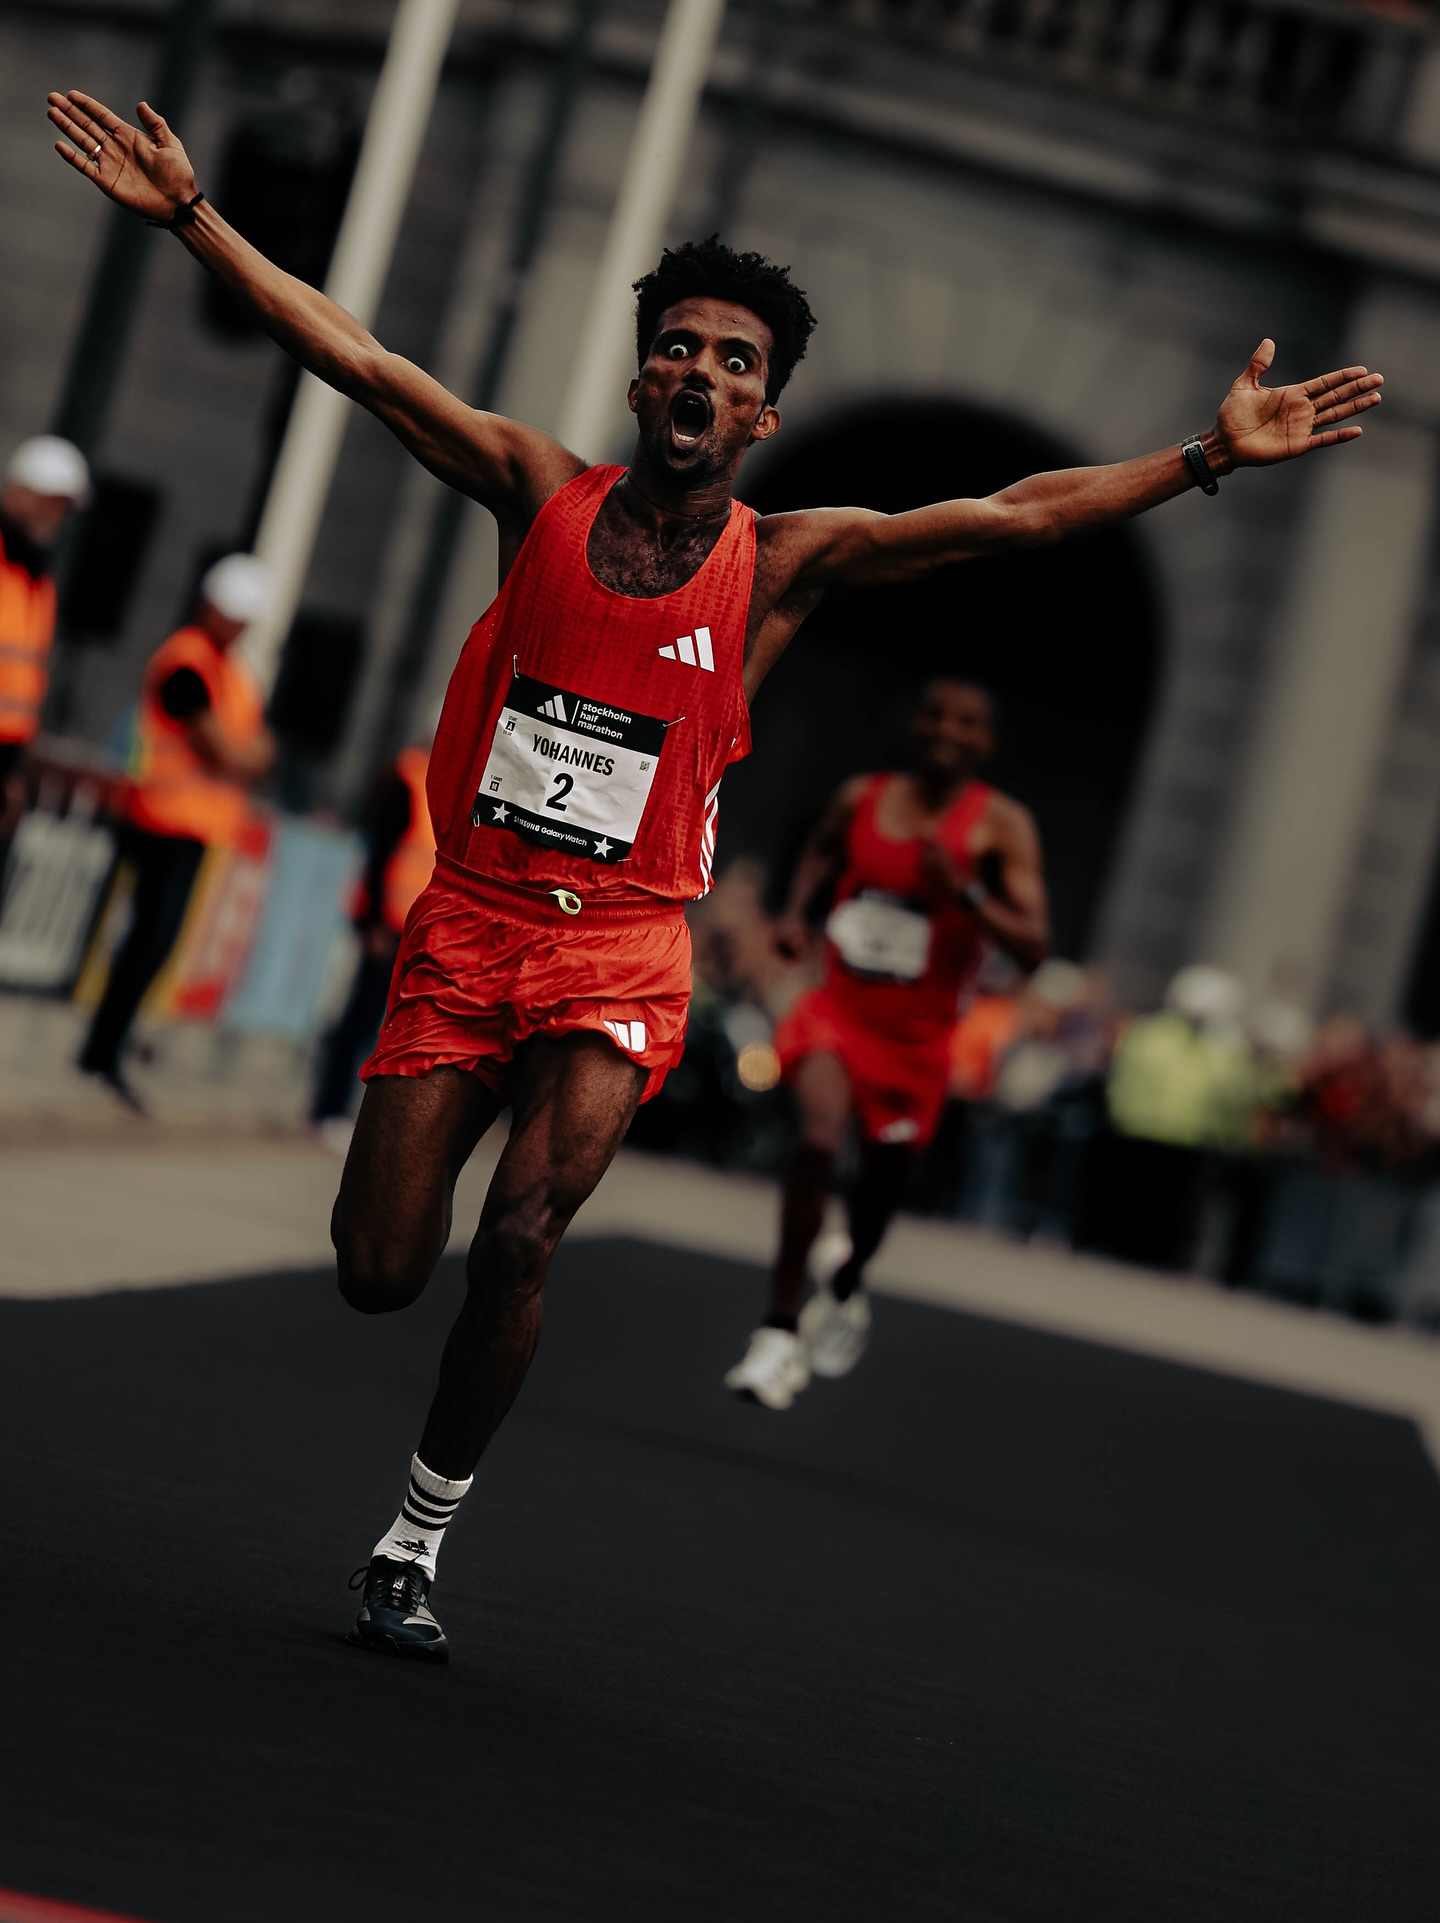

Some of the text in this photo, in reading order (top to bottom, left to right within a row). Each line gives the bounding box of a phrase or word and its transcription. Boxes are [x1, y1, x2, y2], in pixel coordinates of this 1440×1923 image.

[580, 711, 599, 723] half
[582, 703, 632, 724] stockholm
[577, 720, 623, 740] marathon
[532, 733, 615, 776] YOHANNES
[545, 772, 574, 812] 2
